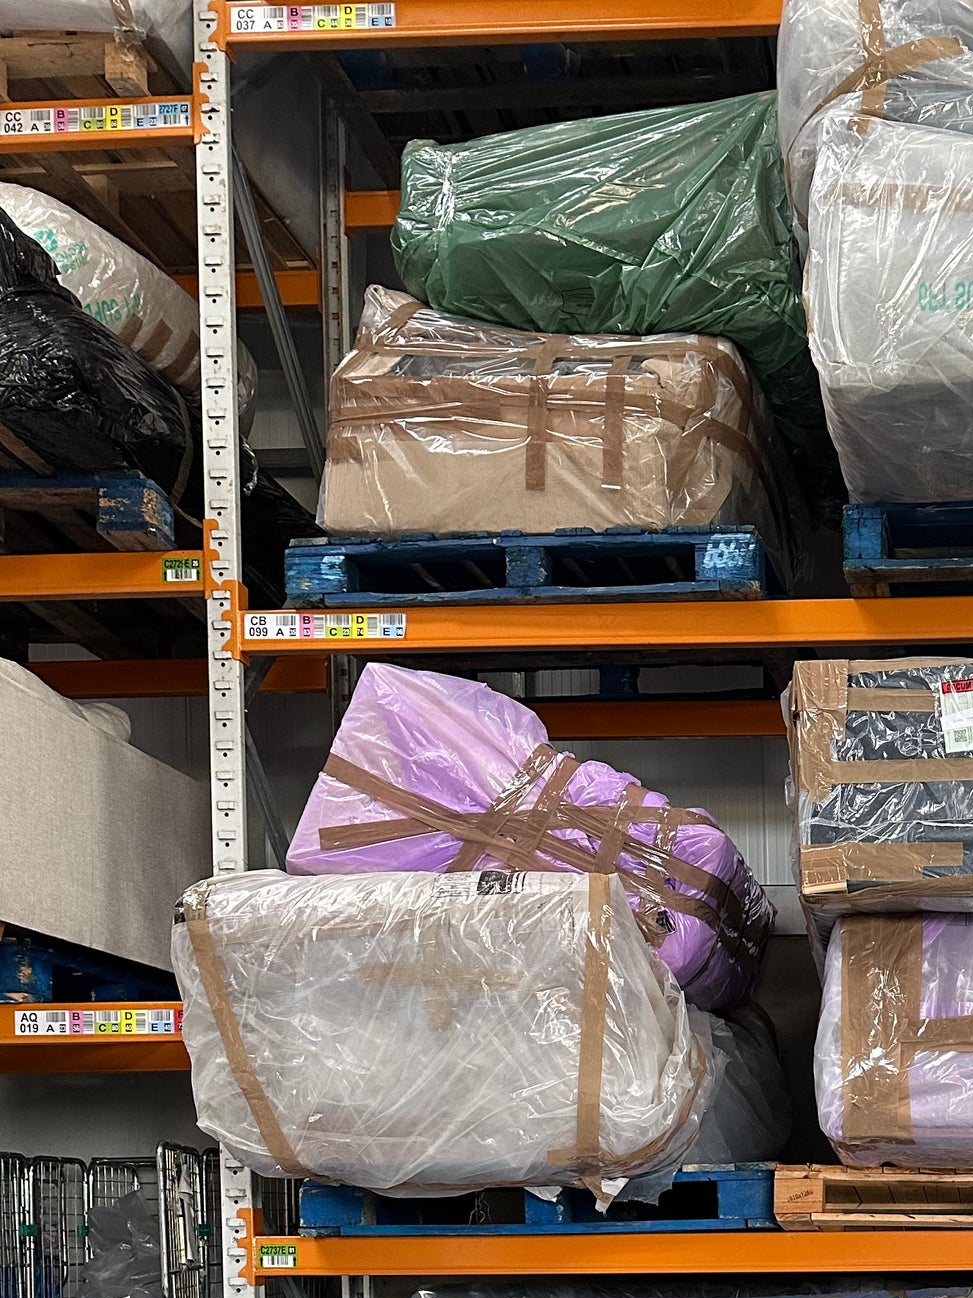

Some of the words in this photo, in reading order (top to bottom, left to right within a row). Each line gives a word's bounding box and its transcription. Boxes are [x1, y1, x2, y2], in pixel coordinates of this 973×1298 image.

[237, 9, 254, 19] CC
[290, 7, 299, 16] B
[344, 6, 353, 16] D
[236, 20, 255, 30] 037
[263, 21, 272, 30] A
[317, 18, 326, 28] C
[371, 17, 379, 26] E
[57, 109, 65, 119] B
[110, 107, 118, 116] D
[5, 112, 22, 122] CC
[136, 117, 144, 127] E
[4, 122, 23, 134] 042
[30, 122, 39, 132] A
[83, 120, 92, 130] C
[250, 616, 267, 626] CB
[302, 615, 311, 625] B
[356, 615, 364, 625] D
[249, 627, 268, 637] 099
[275, 627, 285, 636] A
[329, 627, 338, 636] C
[382, 627, 391, 636] E
[20, 1013, 38, 1023] AQ
[72, 1012, 81, 1021] B
[125, 1011, 133, 1020] D
[19, 1023, 39, 1033] 019
[46, 1024, 55, 1033] A
[98, 1024, 107, 1032] C
[151, 1024, 159, 1032] E
[260, 1245, 287, 1255] C2737E
